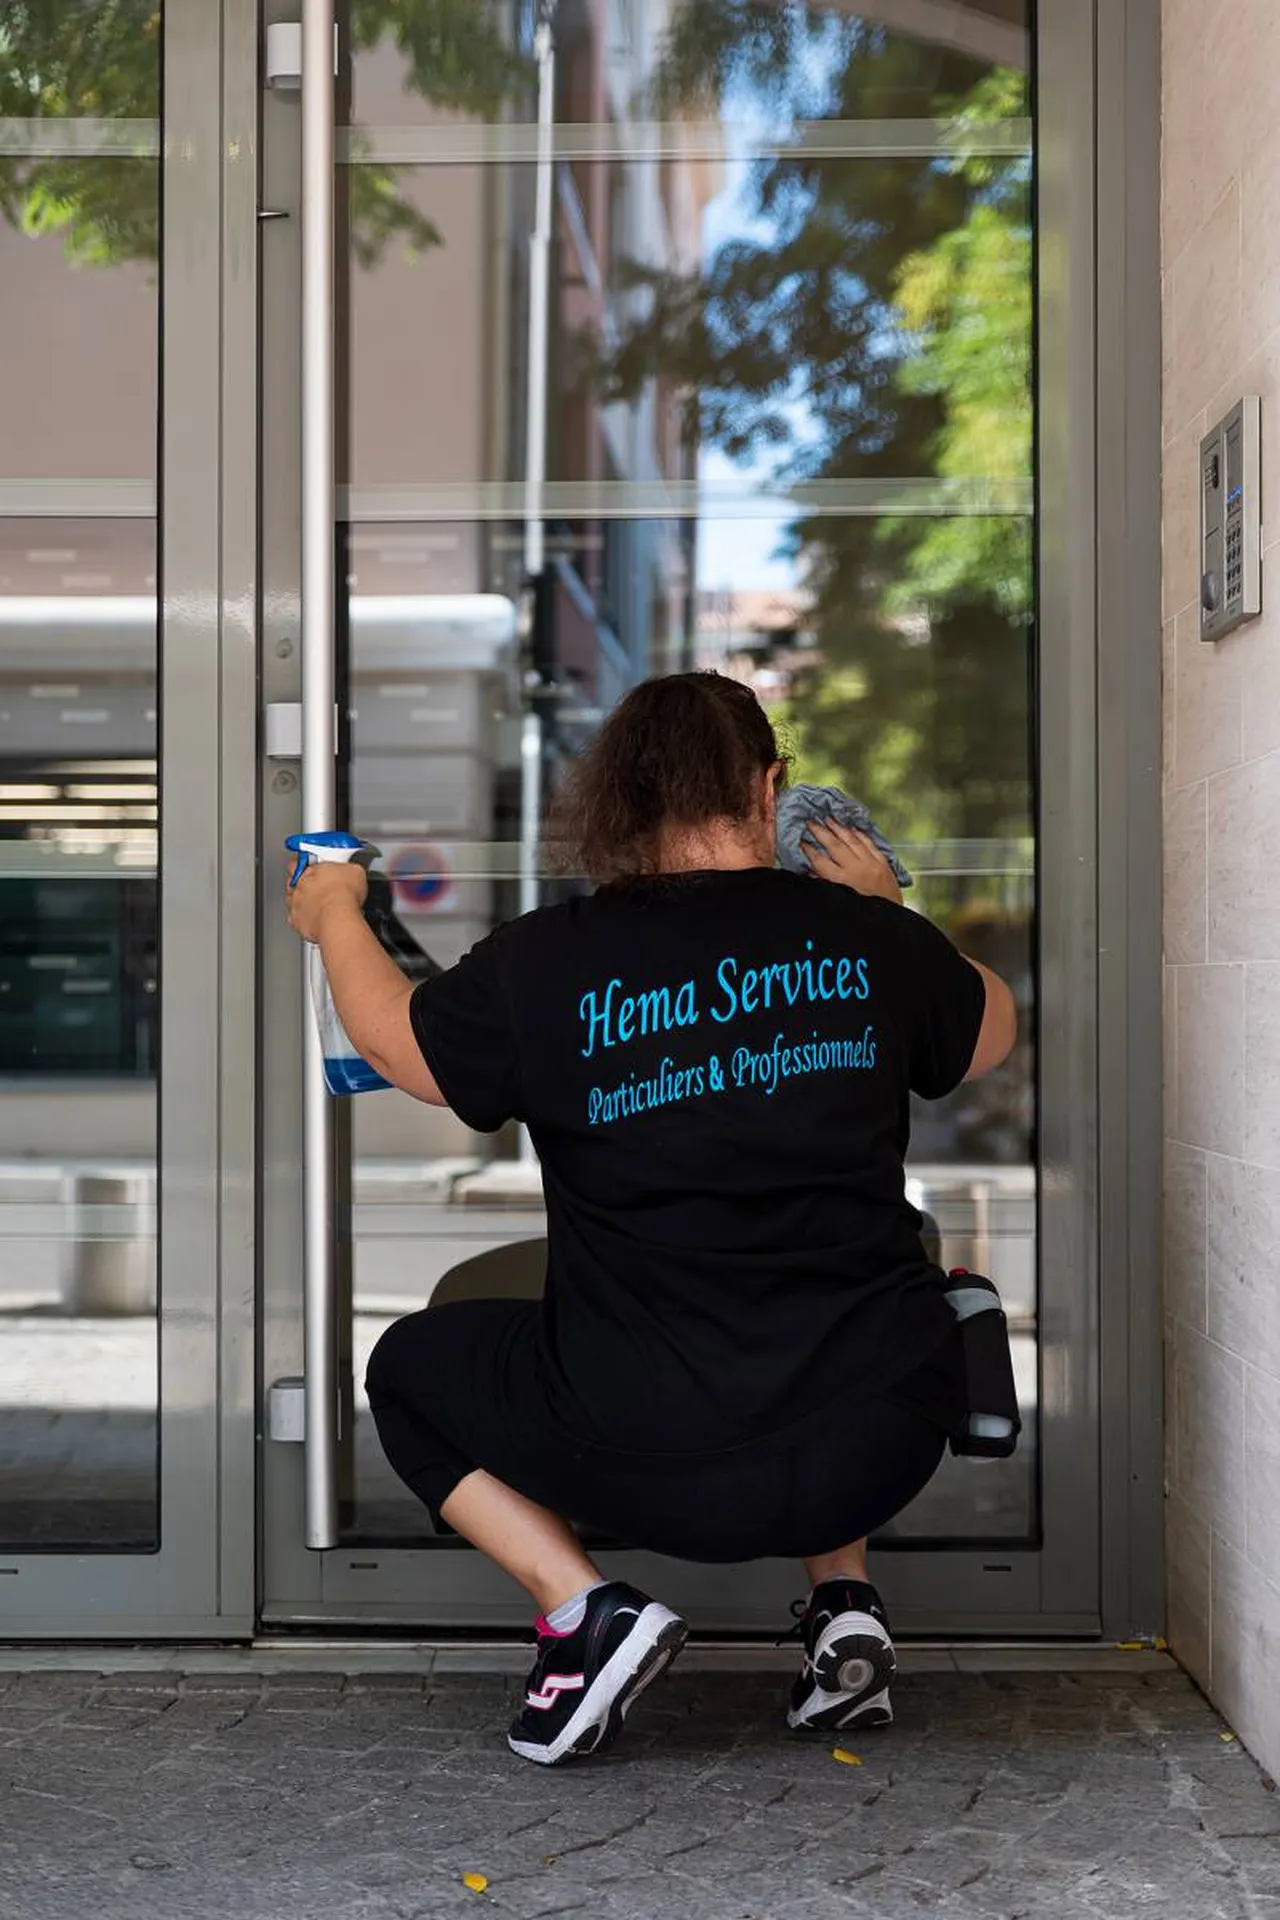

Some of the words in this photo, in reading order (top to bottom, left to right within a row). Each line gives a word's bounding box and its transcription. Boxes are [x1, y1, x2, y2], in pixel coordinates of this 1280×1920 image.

[580, 978, 699, 1057] Hema
[710, 940, 869, 1023] Services
[588, 1057, 705, 1125] Particuliers
[709, 1055, 725, 1092] &
[732, 1025, 877, 1095] Professionnels
